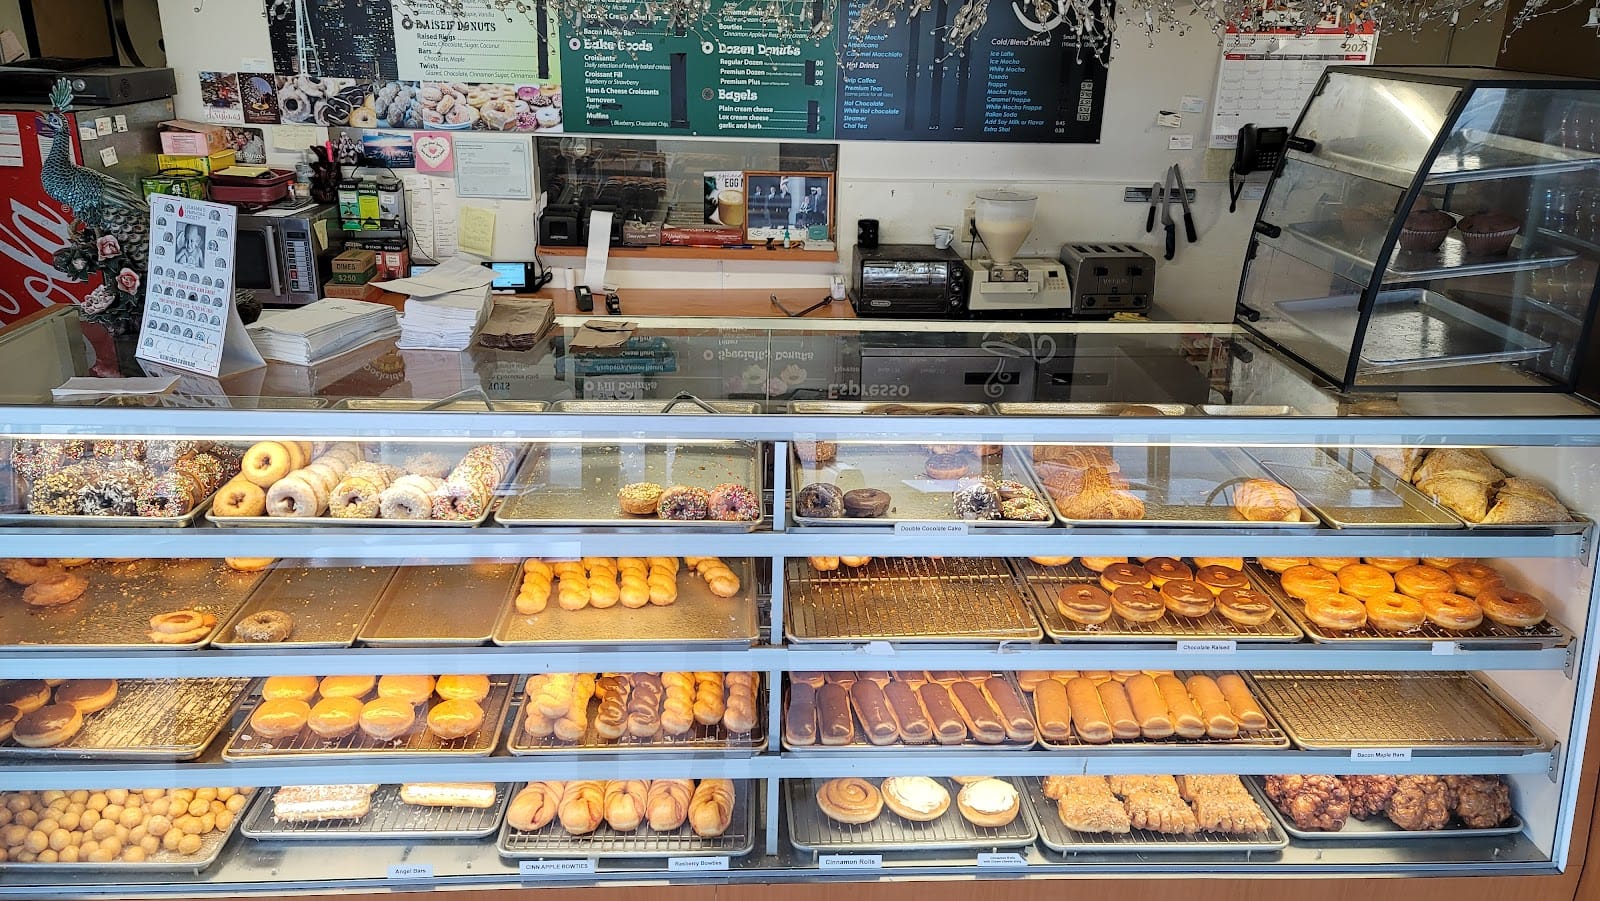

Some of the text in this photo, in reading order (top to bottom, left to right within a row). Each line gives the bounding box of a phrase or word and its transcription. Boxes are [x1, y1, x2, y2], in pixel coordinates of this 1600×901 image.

[718, 43, 801, 56] Dozen Donuts
[718, 88, 758, 102] Bagels
[724, 178, 738, 188] EGG
